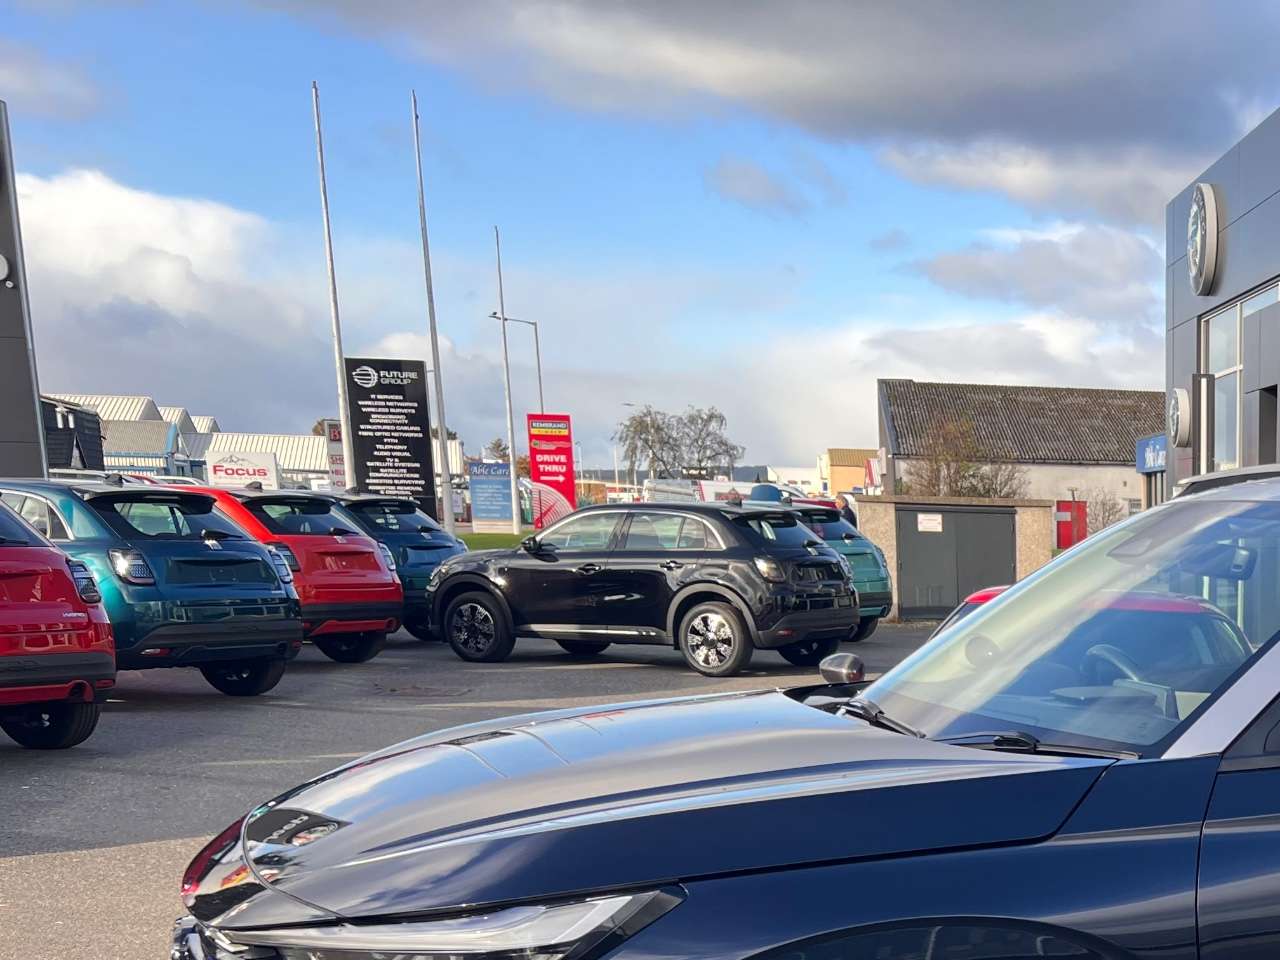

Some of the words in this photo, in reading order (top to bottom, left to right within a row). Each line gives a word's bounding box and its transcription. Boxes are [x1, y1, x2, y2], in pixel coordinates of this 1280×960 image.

[380, 371, 418, 379] FUTURE
[536, 455, 567, 463] DRIVE
[212, 464, 268, 477] Focus
[539, 464, 567, 473] THRU
